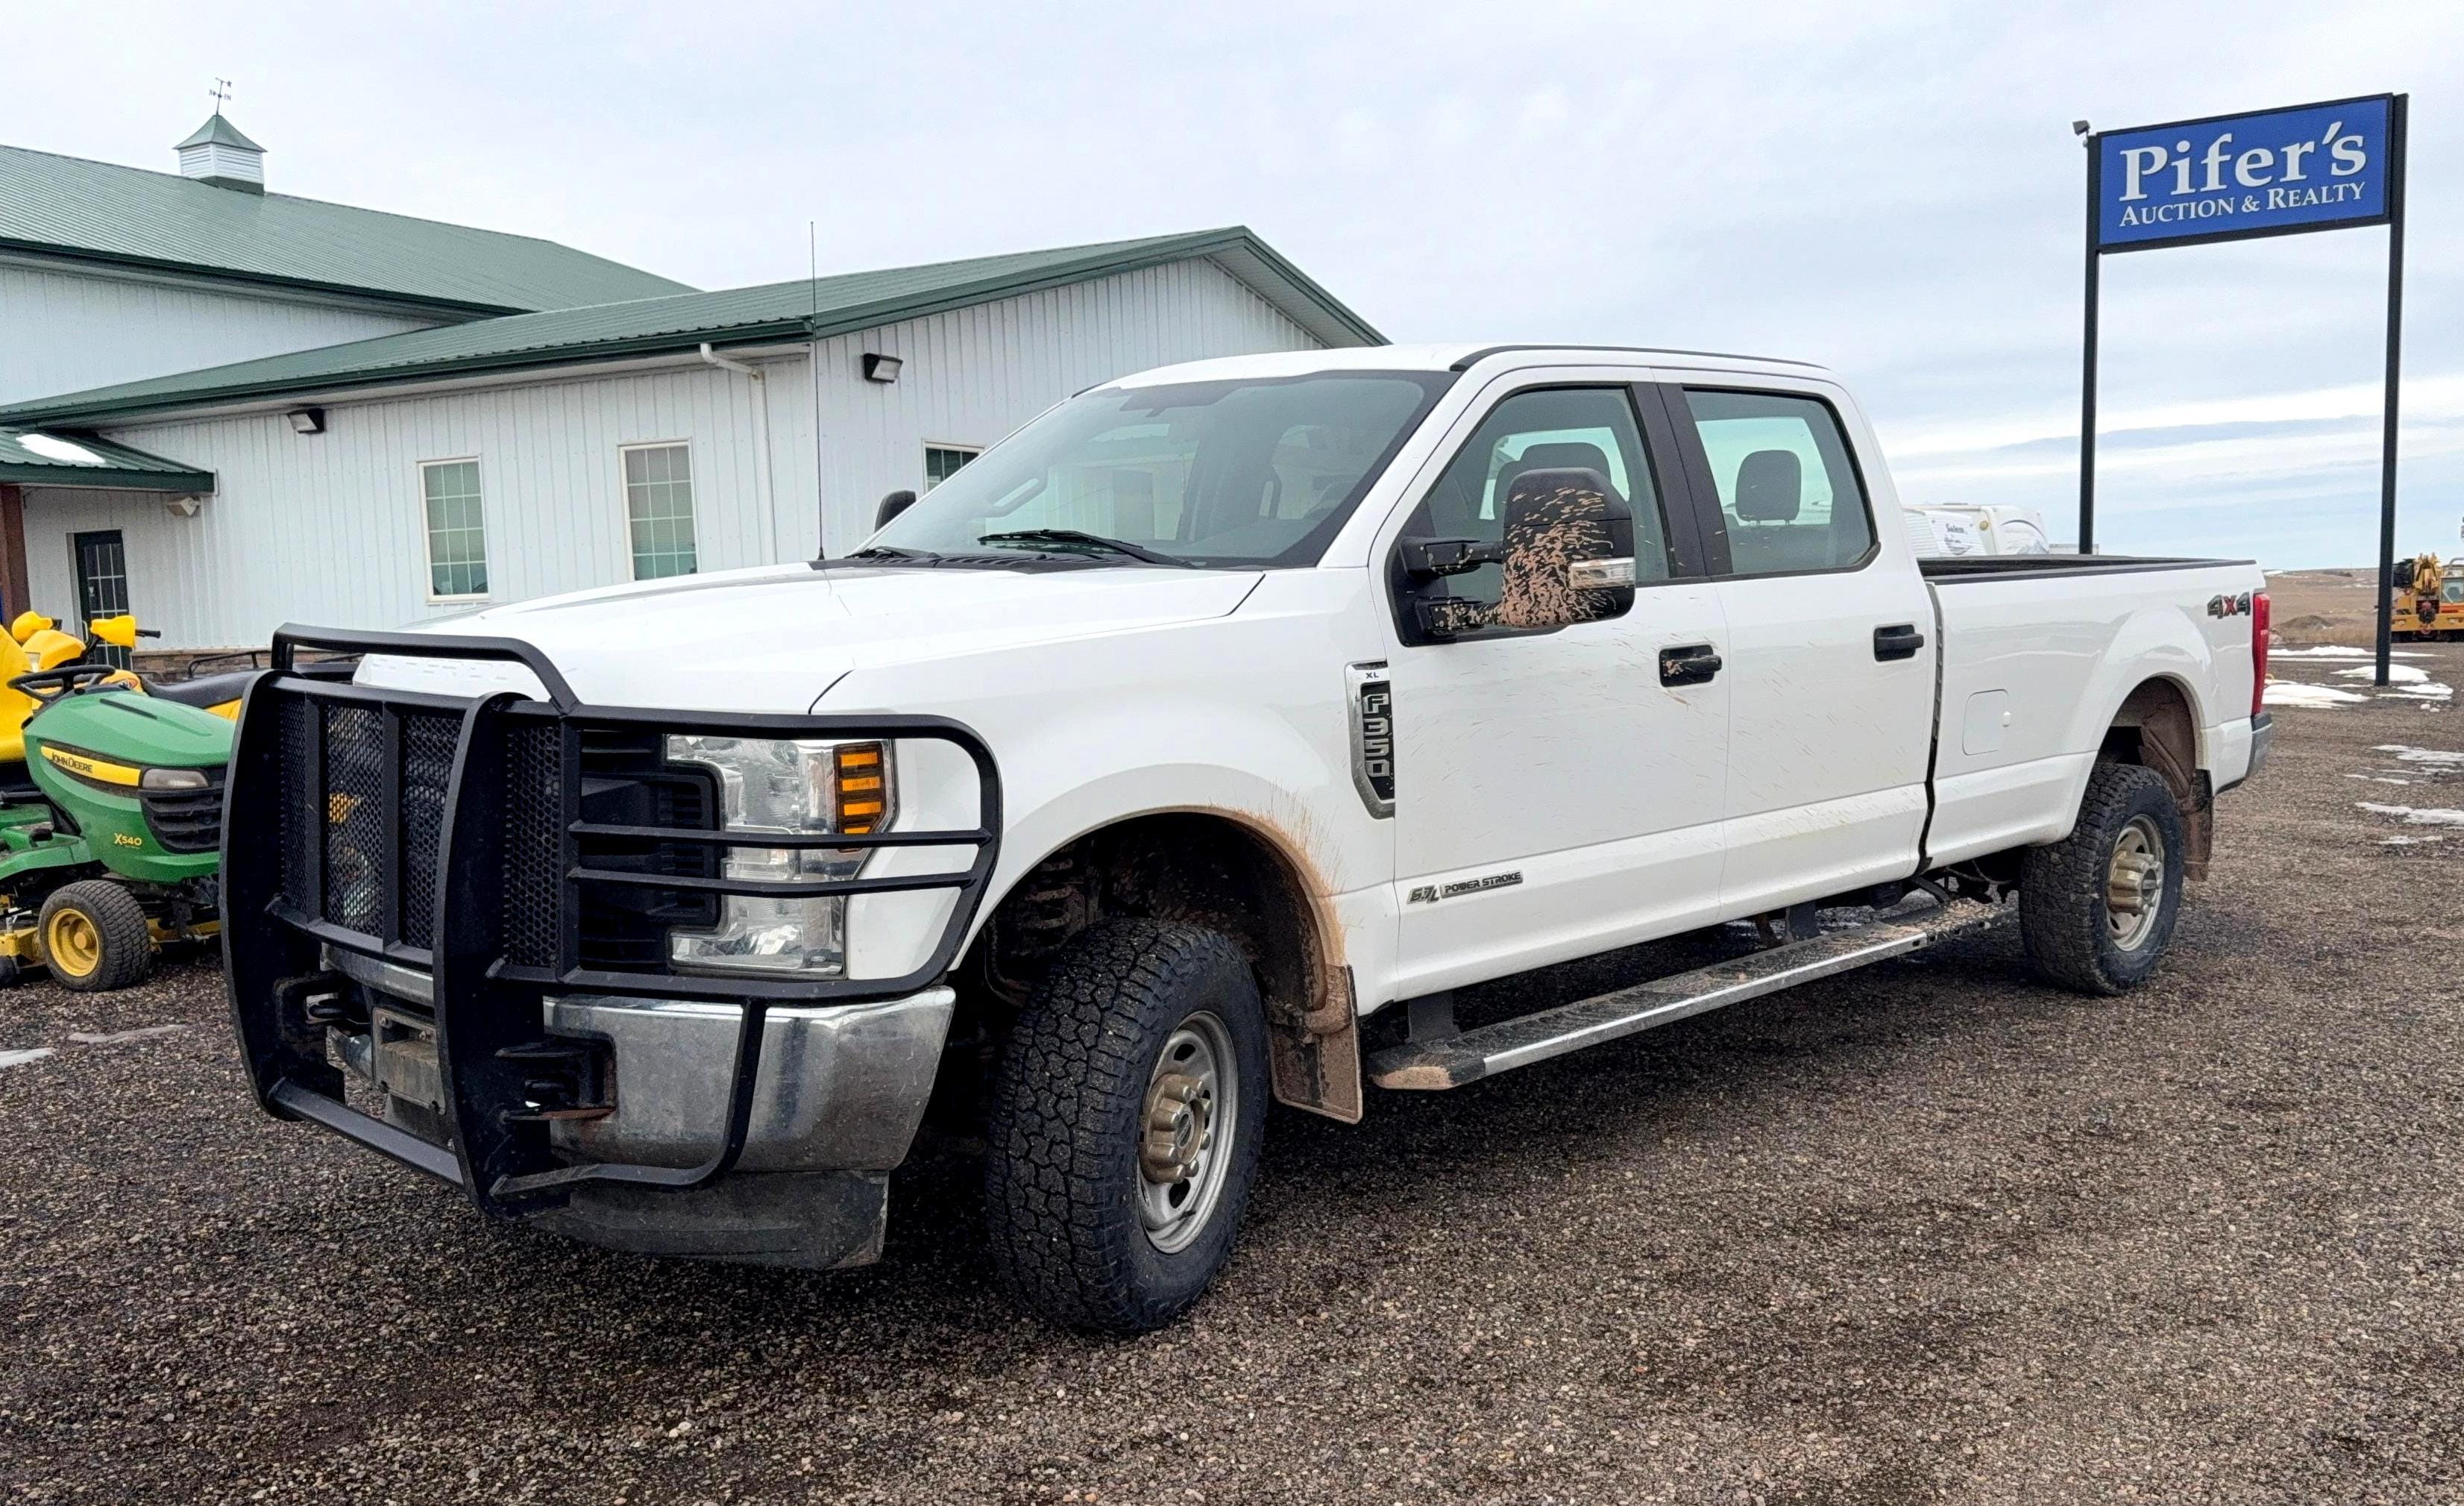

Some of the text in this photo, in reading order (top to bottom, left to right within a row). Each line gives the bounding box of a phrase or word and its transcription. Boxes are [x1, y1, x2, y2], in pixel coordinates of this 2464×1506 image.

[2119, 121, 2367, 201] Pifer's
[2119, 181, 2366, 227] AUCTION & REALTY
[1363, 693, 1390, 777] F350
[52, 752, 93, 774] JOHN DEERE
[114, 832, 142, 846] X540
[1445, 880, 1480, 894] POWER
[1483, 871, 1522, 887] STROKE
